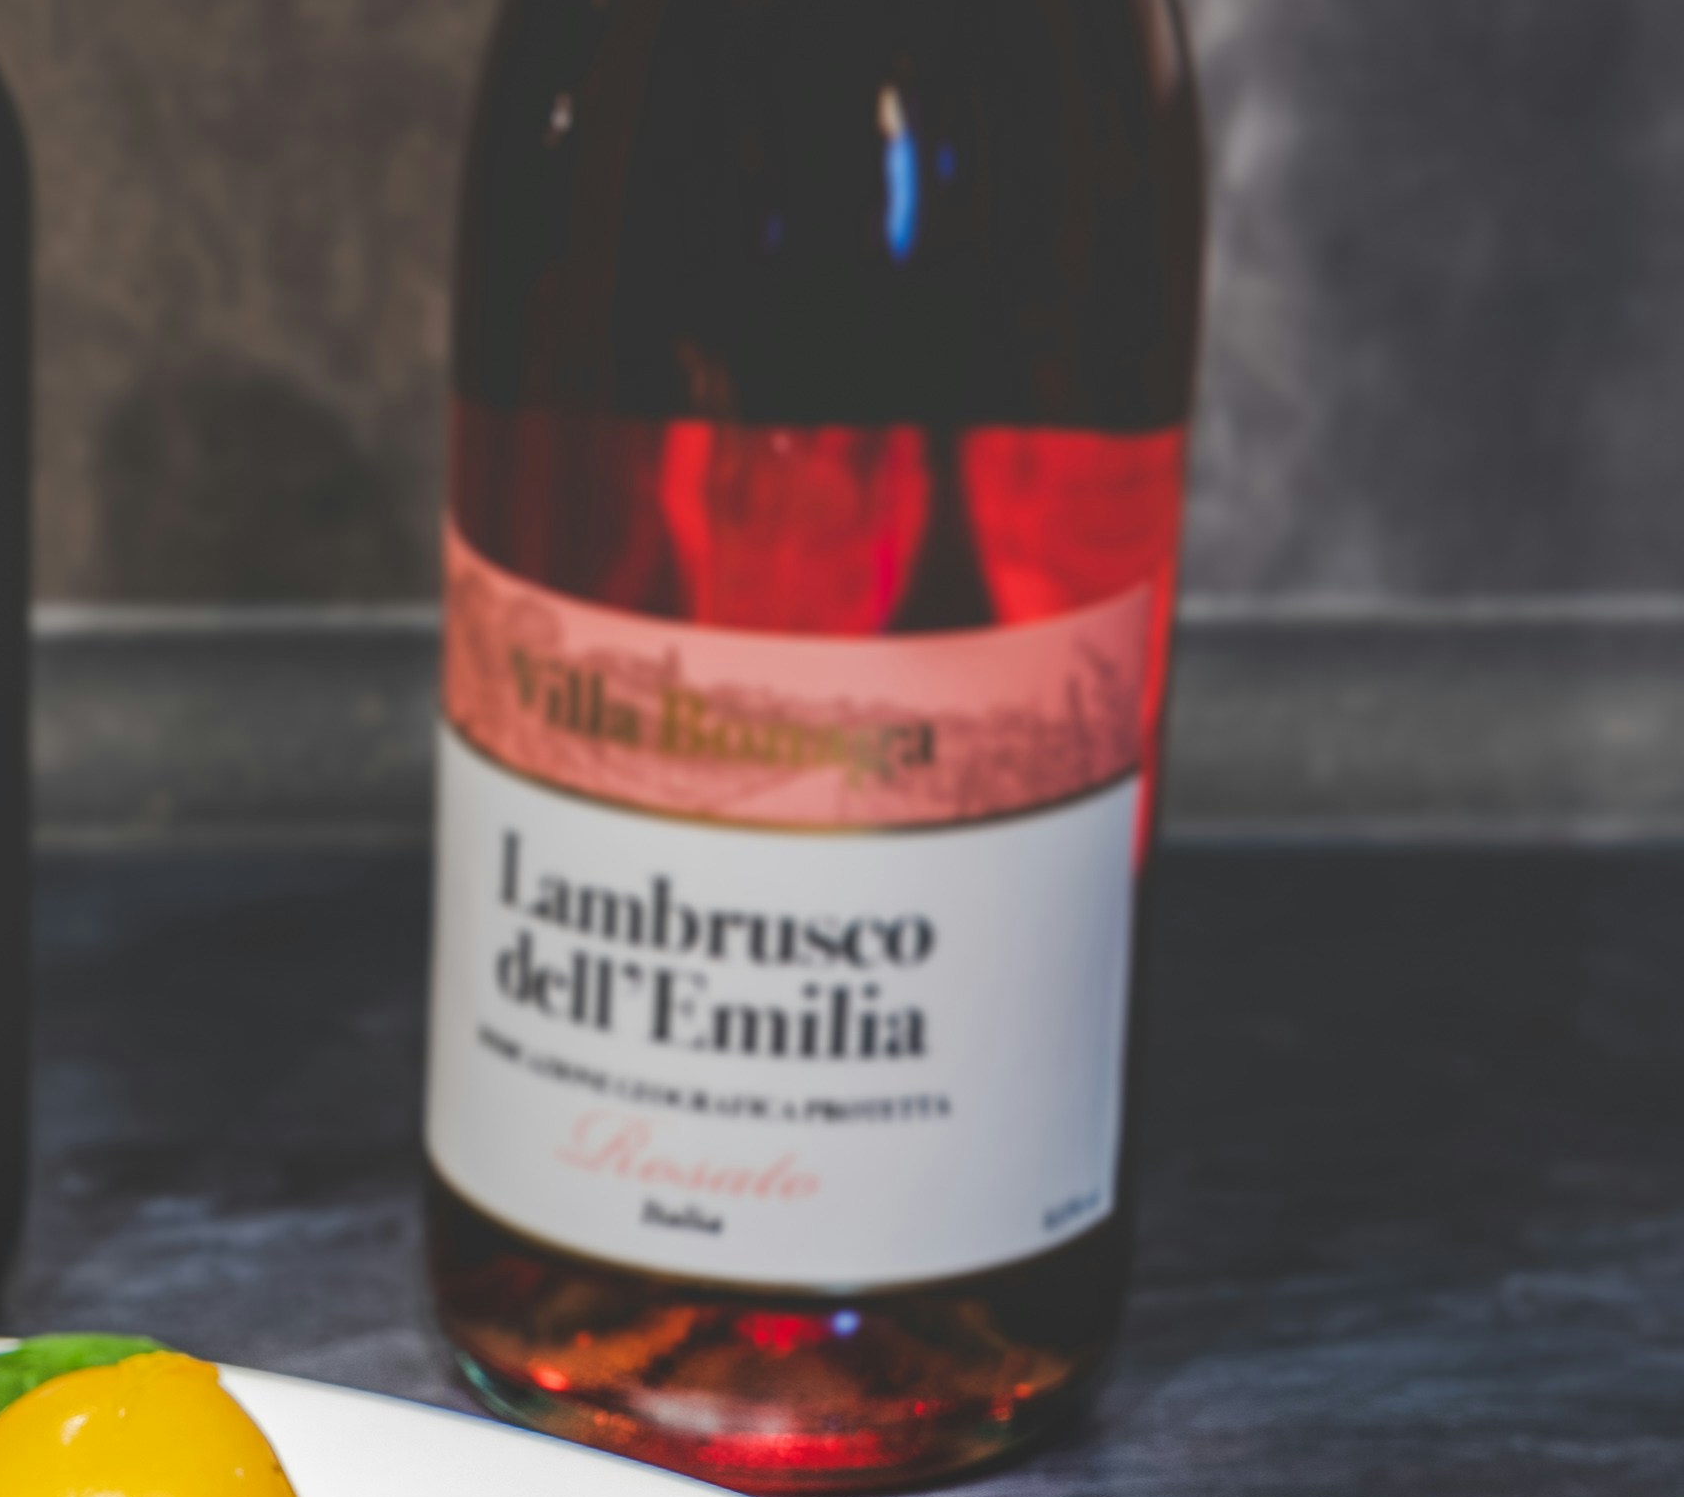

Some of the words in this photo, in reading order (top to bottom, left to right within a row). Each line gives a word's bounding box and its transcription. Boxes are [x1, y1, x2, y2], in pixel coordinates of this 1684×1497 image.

[509, 643, 642, 751] Villa
[499, 828, 940, 971] Lambrusco
[493, 927, 930, 1063] dell'Emilia
[552, 1106, 826, 1202] Rosato
